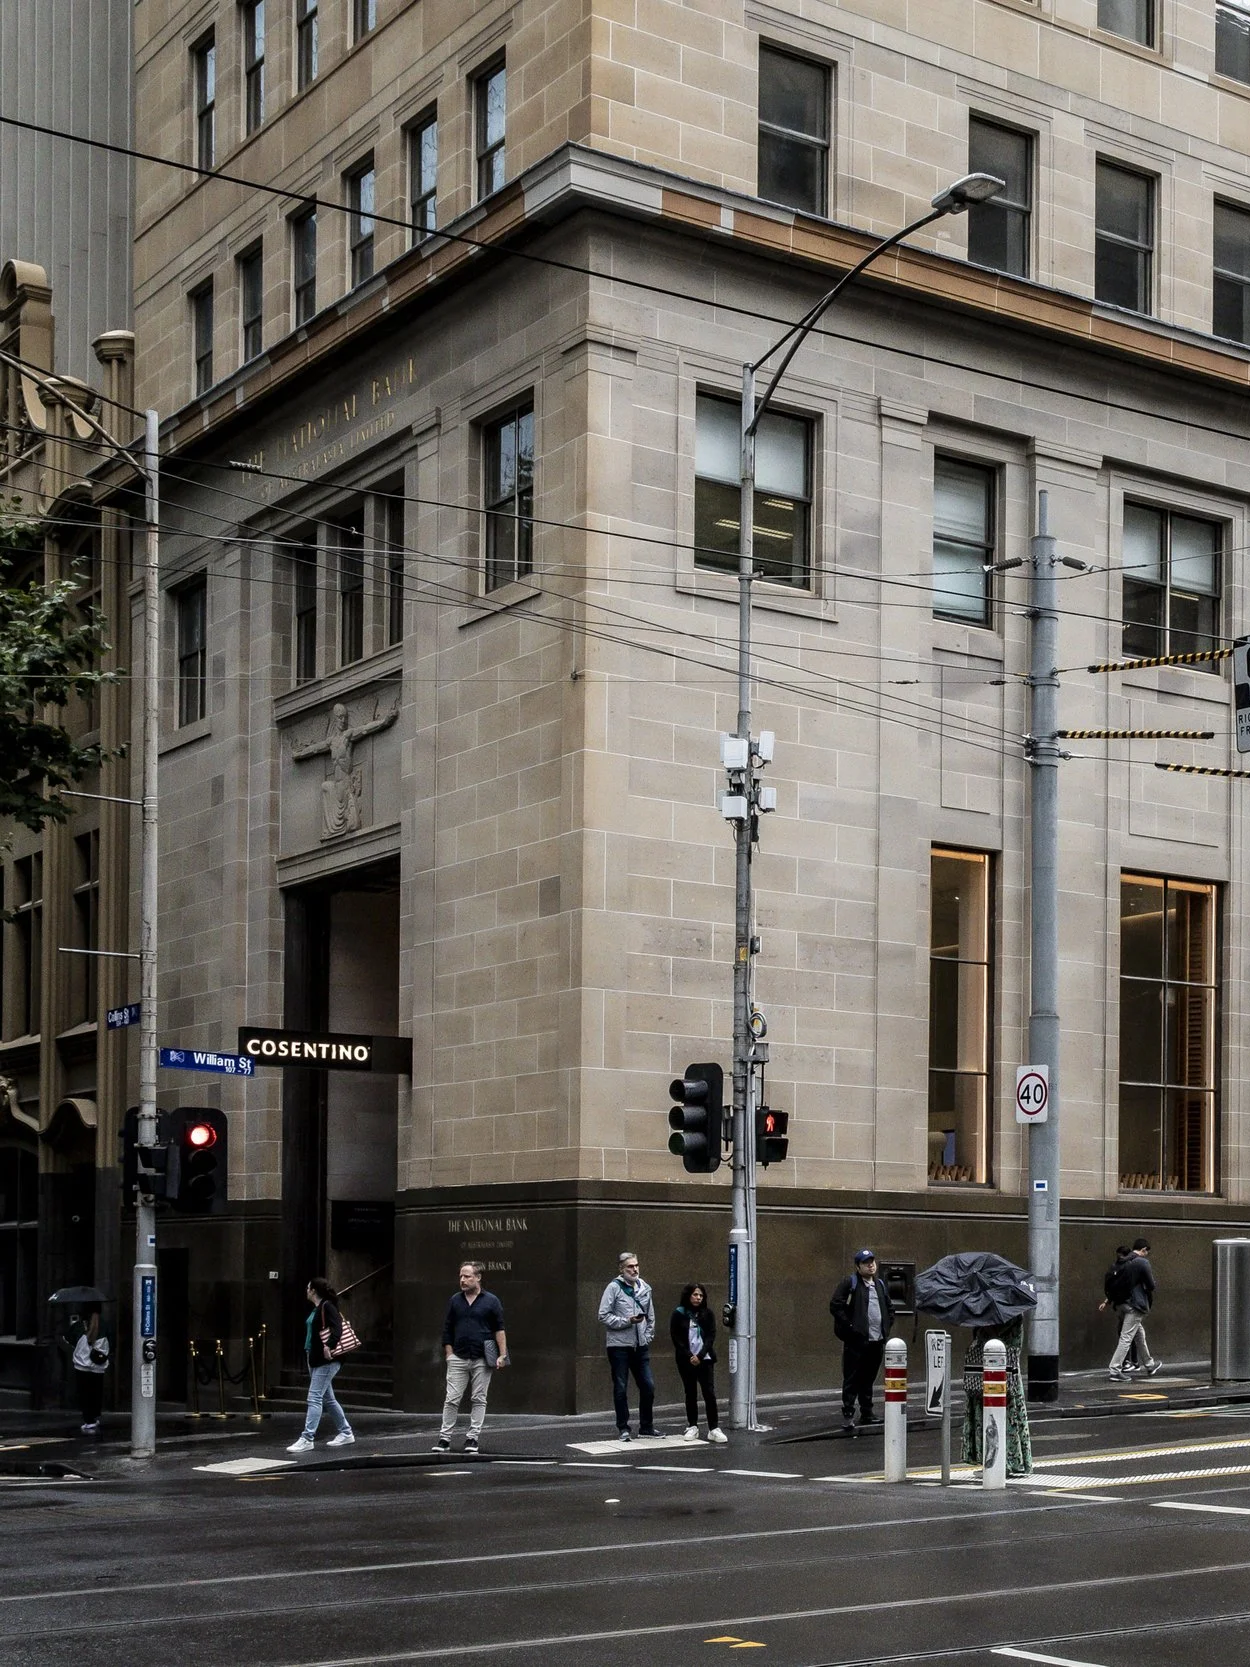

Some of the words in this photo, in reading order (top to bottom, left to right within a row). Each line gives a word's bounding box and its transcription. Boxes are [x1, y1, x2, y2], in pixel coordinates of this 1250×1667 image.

[371, 357, 417, 406] BANK
[108, 1010, 122, 1023] Collins
[246, 1038, 369, 1062] COSENTINO
[193, 1052, 235, 1067] William
[238, 1056, 251, 1068] St
[1020, 1083, 1044, 1104] 40
[448, 1220, 460, 1232] THE
[464, 1218, 503, 1232] NATIONAL
[506, 1217, 528, 1231] BANK
